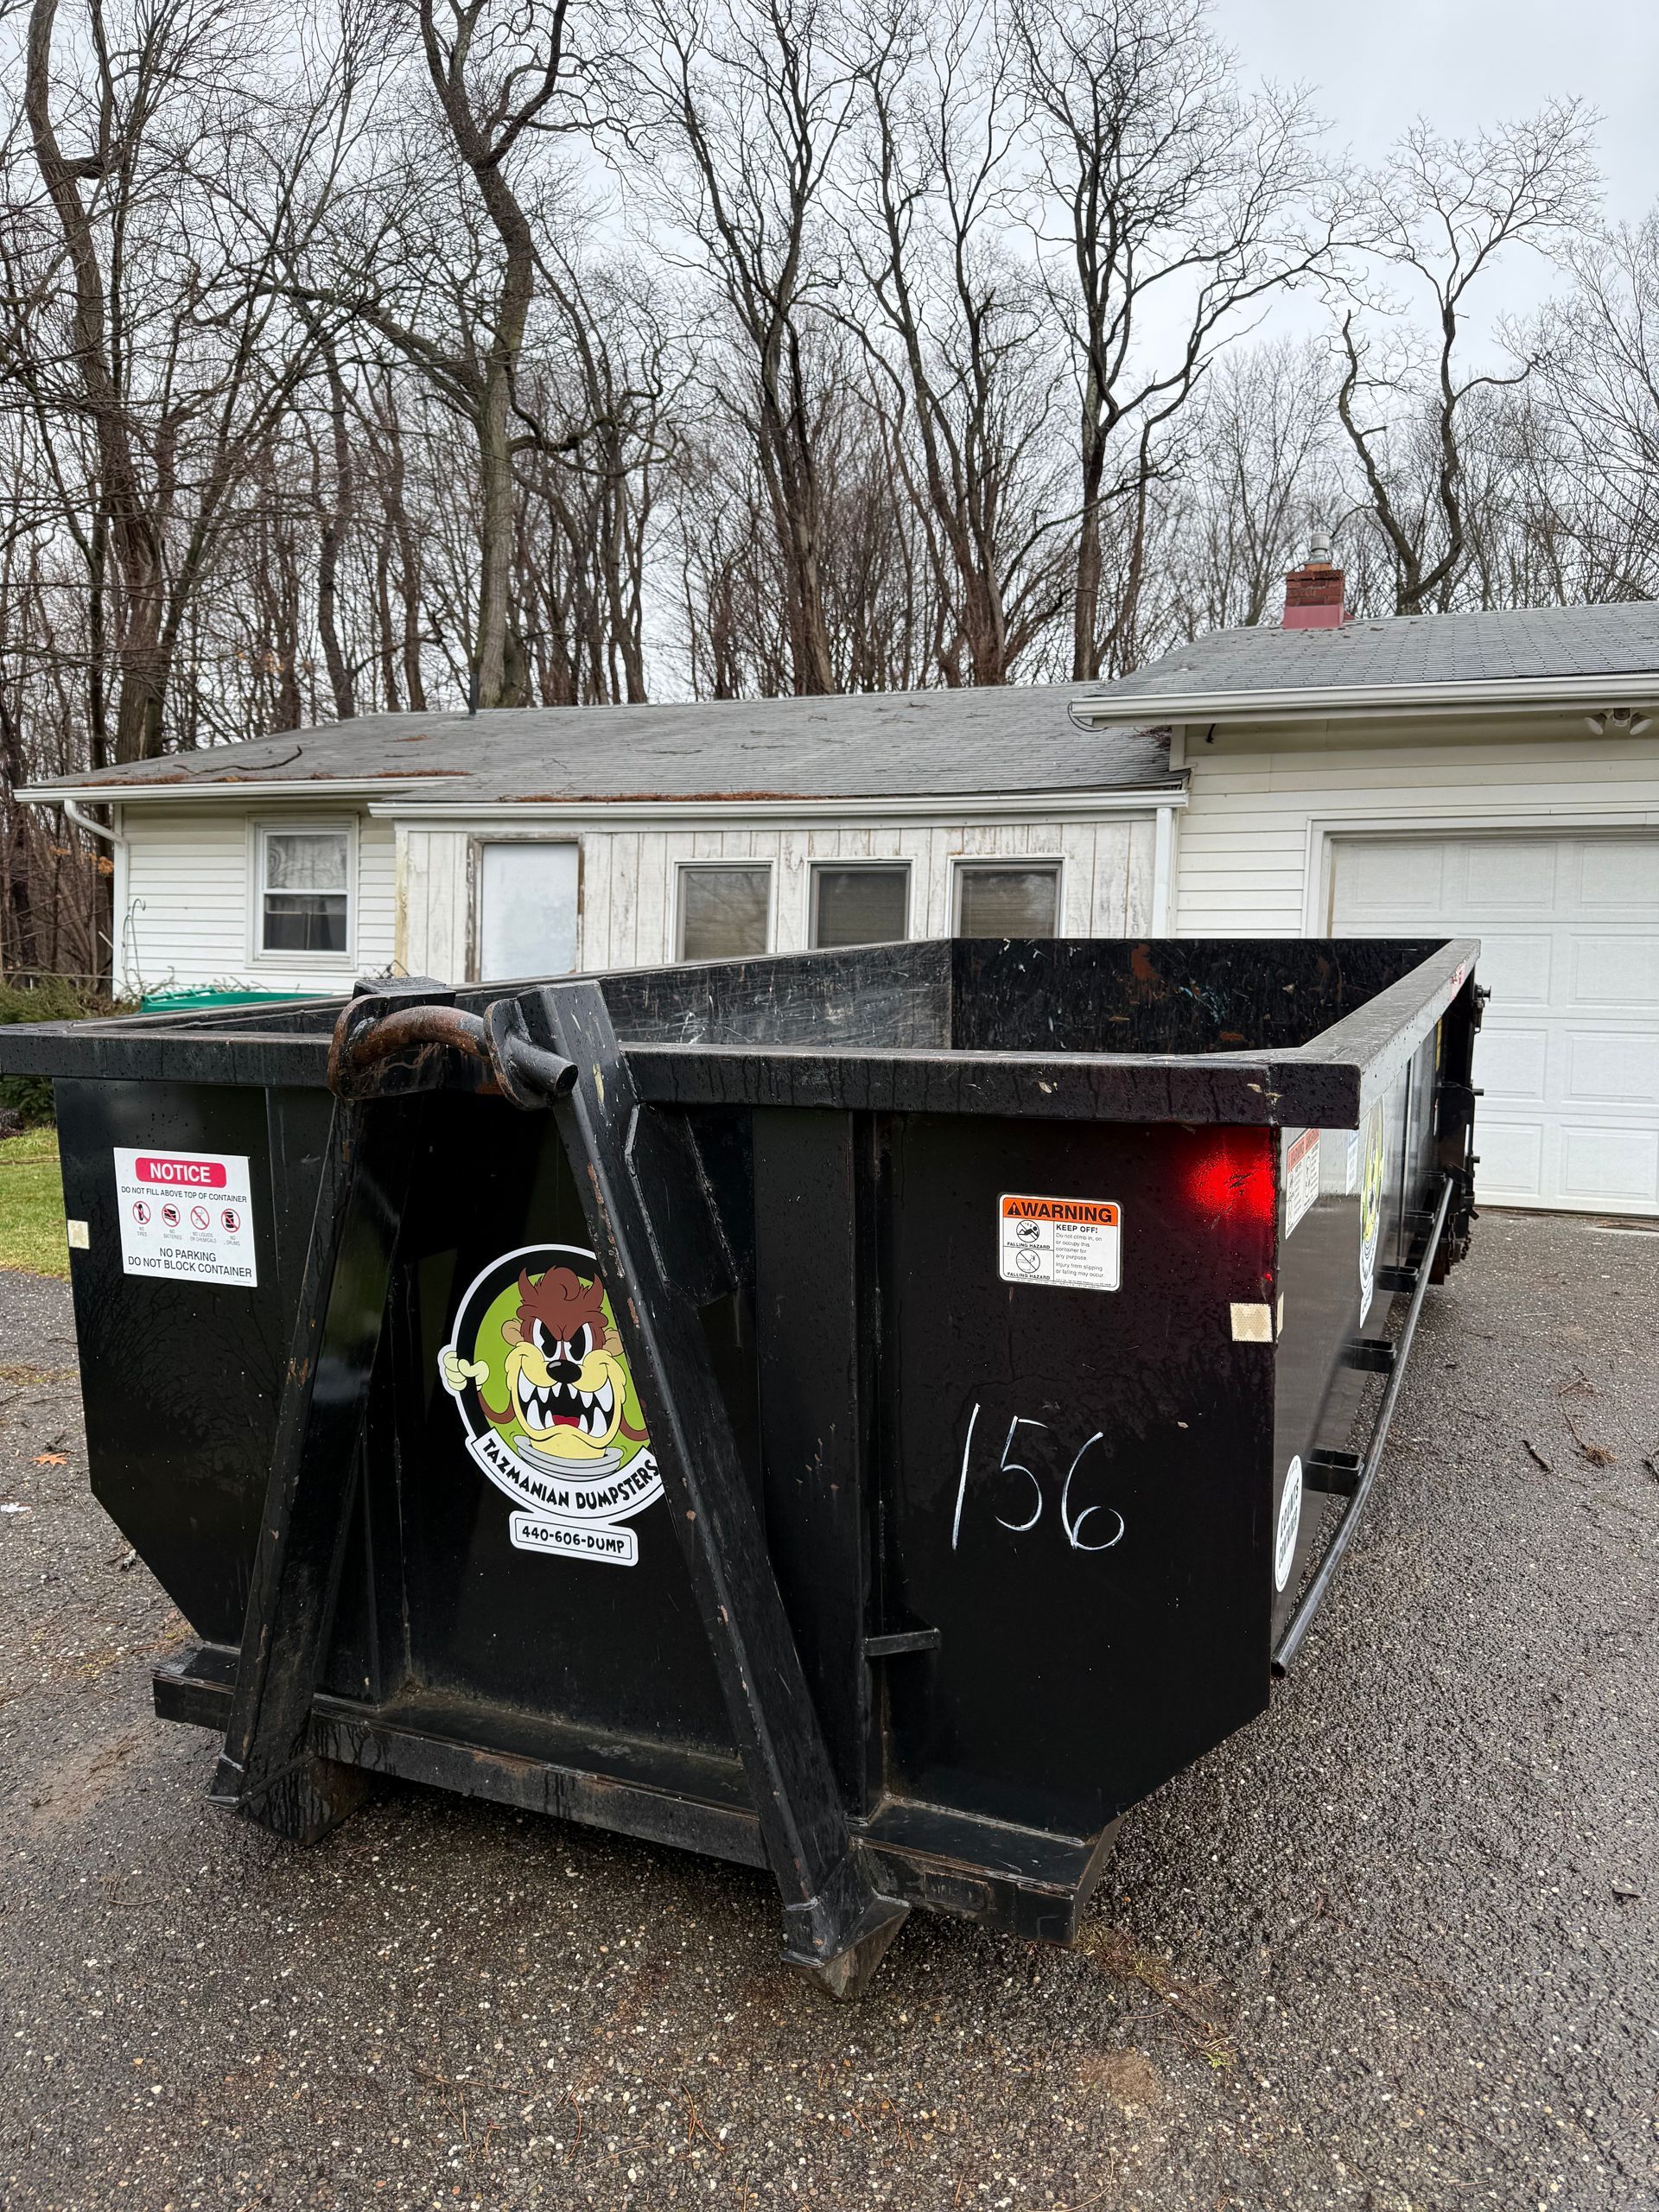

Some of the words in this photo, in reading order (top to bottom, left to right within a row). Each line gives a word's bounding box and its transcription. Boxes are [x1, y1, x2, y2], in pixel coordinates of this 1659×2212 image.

[149, 1162, 212, 1183] NOTICE
[161, 1189, 183, 1198] ABOVE
[208, 1193, 247, 1203] CONTAINER
[1020, 1201, 1112, 1224] WARNING
[1080, 1225, 1098, 1234] OFF!
[160, 1247, 173, 1257] NO
[175, 1249, 216, 1262] PARKING
[128, 1255, 141, 1266] DO
[143, 1257, 162, 1268] NOT
[164, 1259, 196, 1272] BLOCK
[198, 1262, 252, 1278] CONTAINER
[482, 1438, 569, 1509] TAZMANIAN
[575, 1459, 660, 1510] DUMPSTERS
[952, 1402, 1124, 1551] 156
[522, 1525, 625, 1554] 440-606-DUMP
